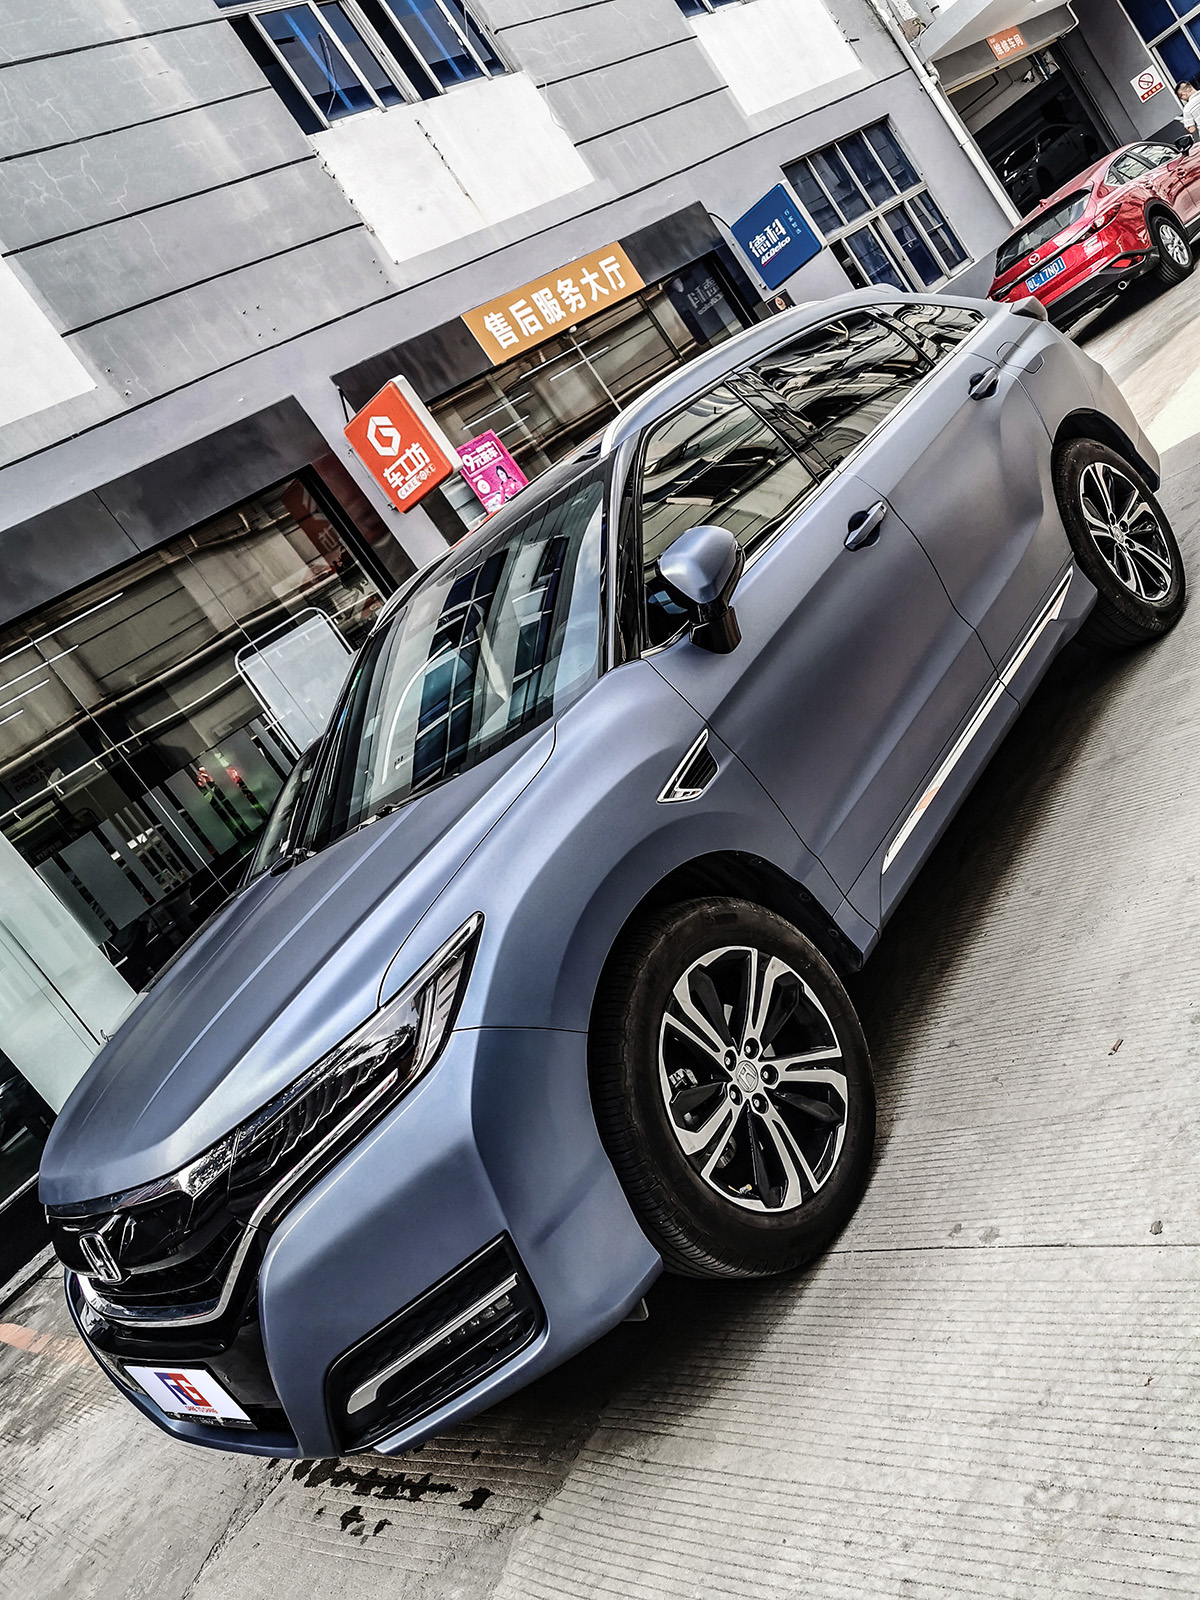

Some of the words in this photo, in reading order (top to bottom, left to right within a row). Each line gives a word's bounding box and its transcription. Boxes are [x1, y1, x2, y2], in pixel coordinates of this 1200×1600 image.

[748, 218, 787, 258] 德科
[760, 236, 791, 265] ACDelco
[483, 255, 626, 350] 售后服务大厅
[382, 442, 431, 489] 车工坊
